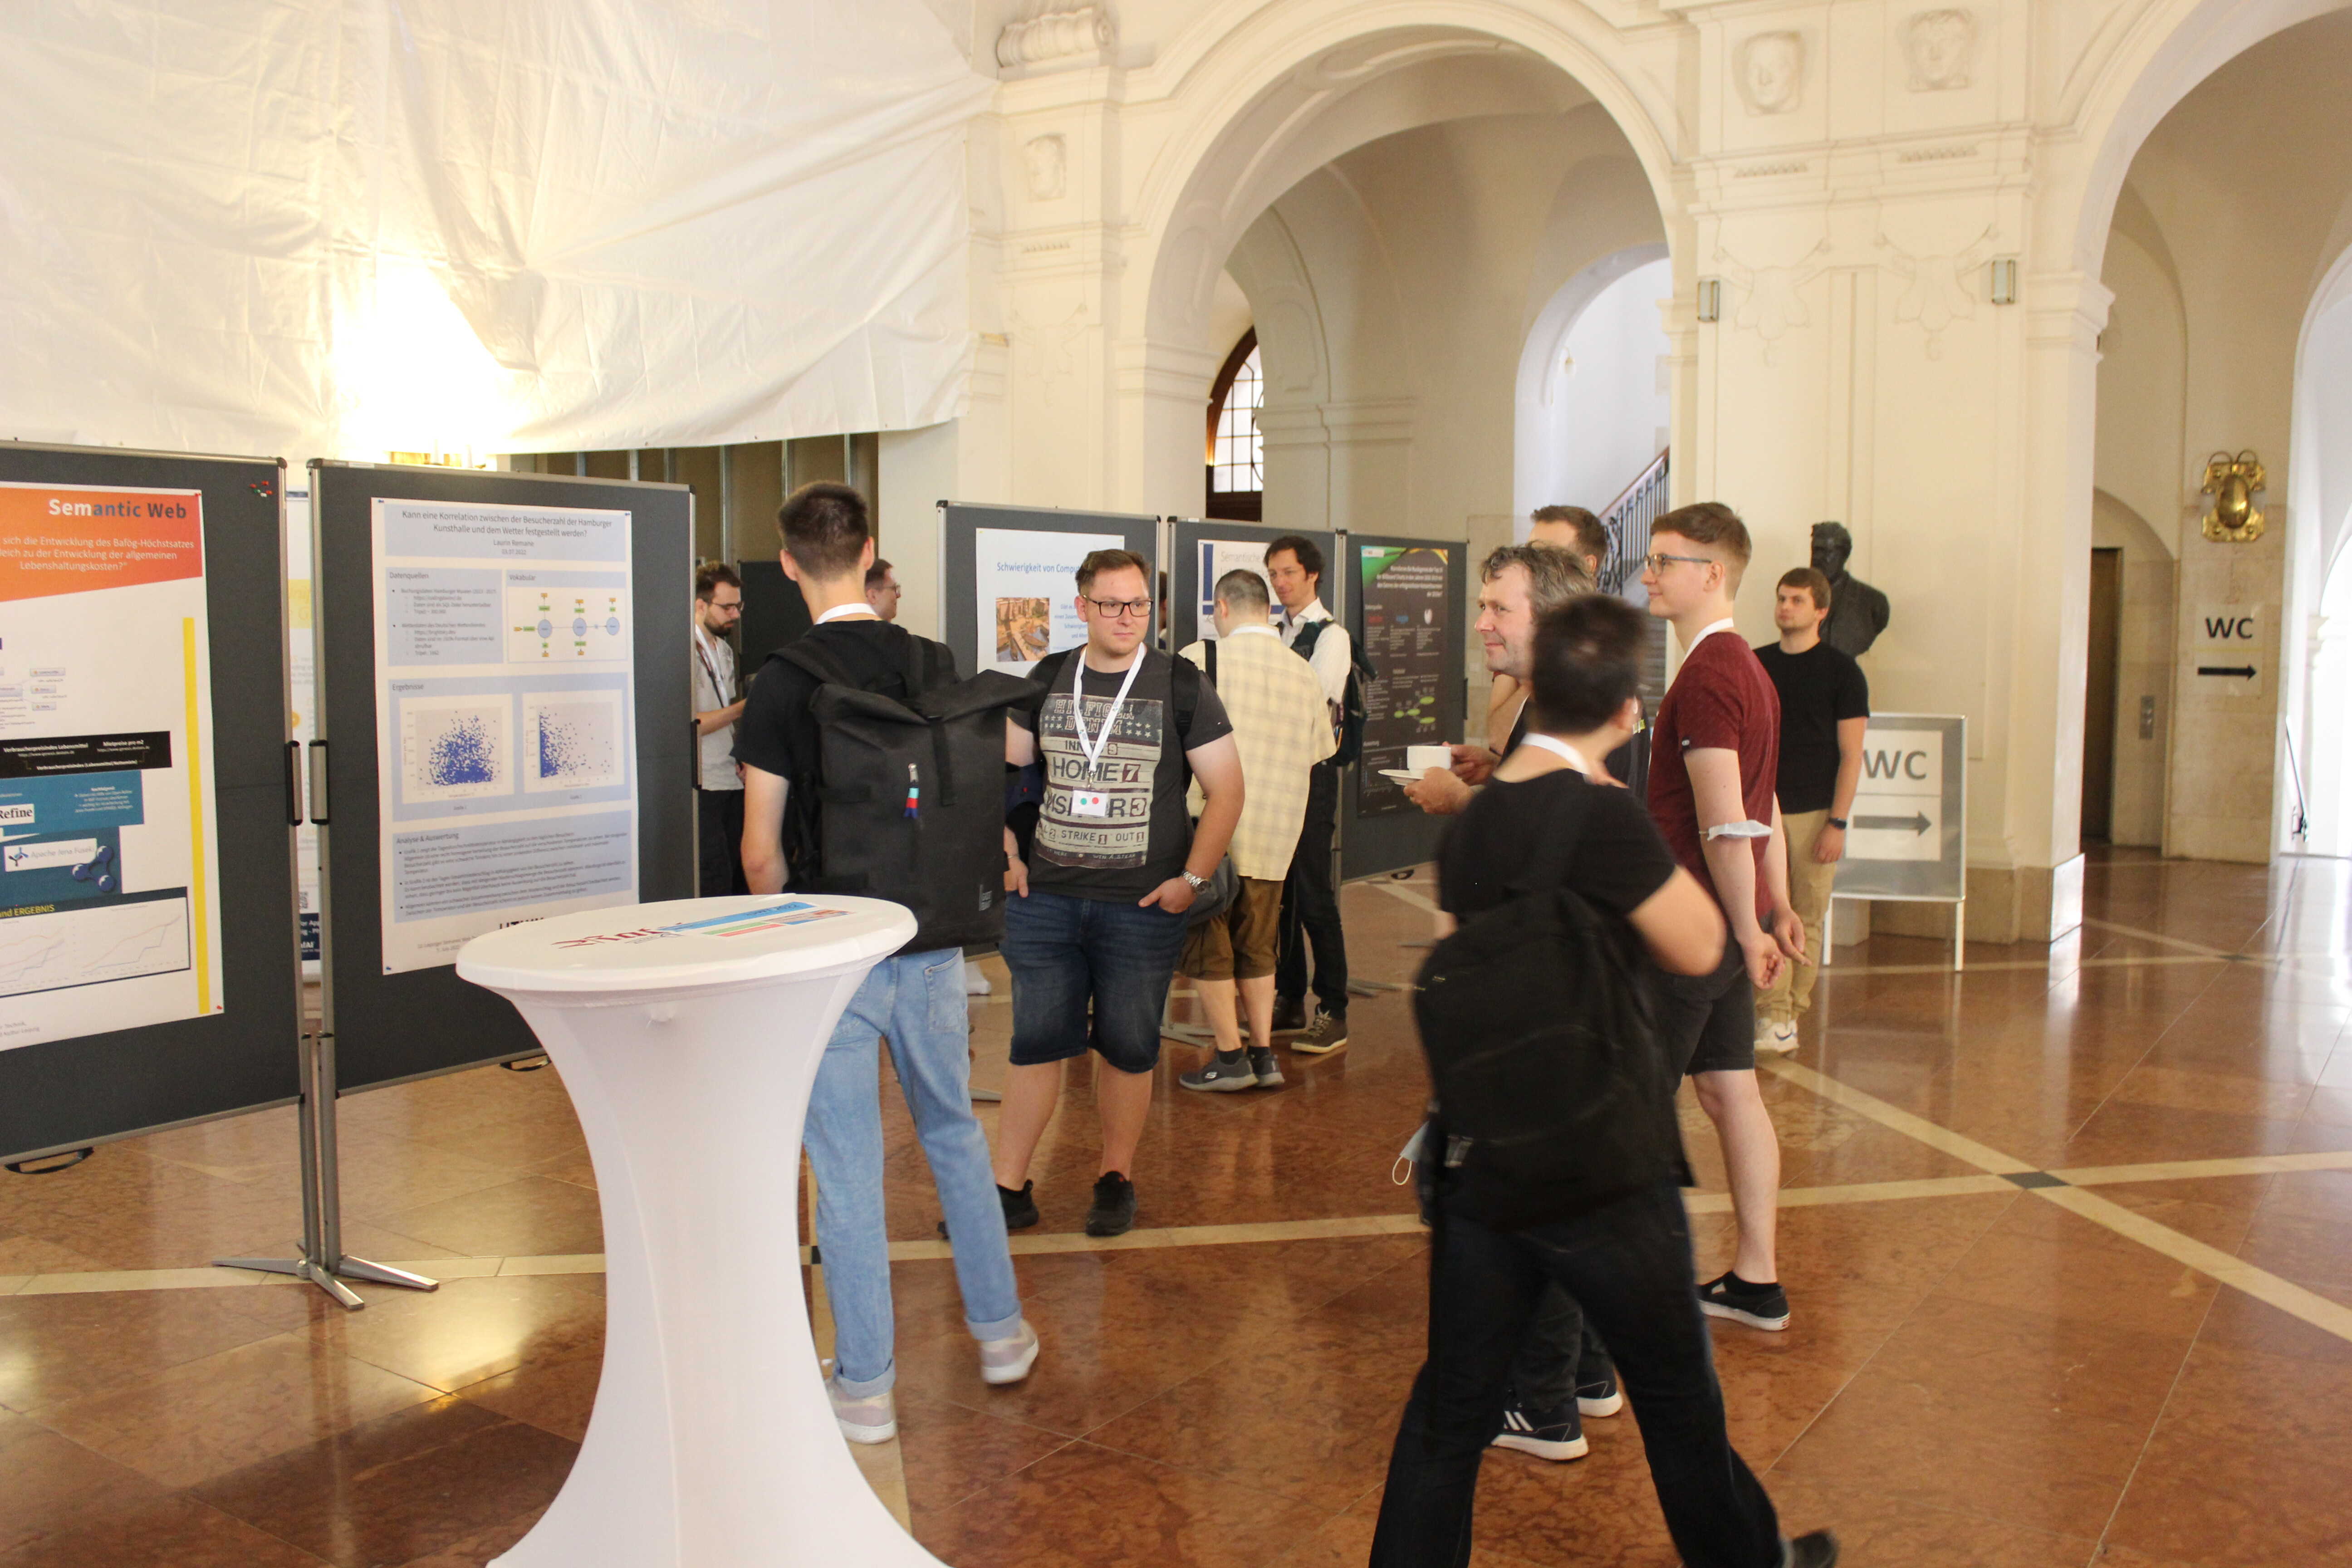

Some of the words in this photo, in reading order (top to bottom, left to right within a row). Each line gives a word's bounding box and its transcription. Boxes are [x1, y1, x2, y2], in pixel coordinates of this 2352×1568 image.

[48, 498, 142, 517] Semantic
[147, 502, 187, 519] Web
[402, 510, 421, 520] Kann
[422, 512, 438, 520] eine
[439, 512, 478, 522] Korrelation
[479, 514, 510, 523] zwischen
[511, 515, 522, 524] der
[523, 516, 566, 525] Besucherzahl
[567, 517, 577, 526] der
[578, 518, 612, 528] Hamburger
[433, 524, 471, 534] Kunsthalle
[472, 525, 485, 534] und
[486, 526, 502, 534] dem
[503, 526, 524, 535] Wetter
[525, 527, 560, 538] festgestellt
[561, 529, 588, 538] werden?
[24, 537, 37, 545] die
[40, 537, 93, 548] Entwicklung
[96, 538, 111, 547] des
[36, 549, 51, 558] der
[54, 549, 107, 560] Entwicklung
[109, 550, 123, 559] der
[126, 551, 177, 561] allgemeinen
[997, 562, 1041, 574] Schwierigkeit
[2206, 616, 2254, 640] WC
[392, 683, 424, 691] Ergebnisse
[1053, 756, 1120, 781] HOME
[1123, 764, 1141, 782] 7
[1863, 750, 1927, 780] WC
[1061, 830, 1096, 841] STRIKE
[1115, 832, 1135, 842] OUT
[14, 904, 55, 916] ERGEBNIS
